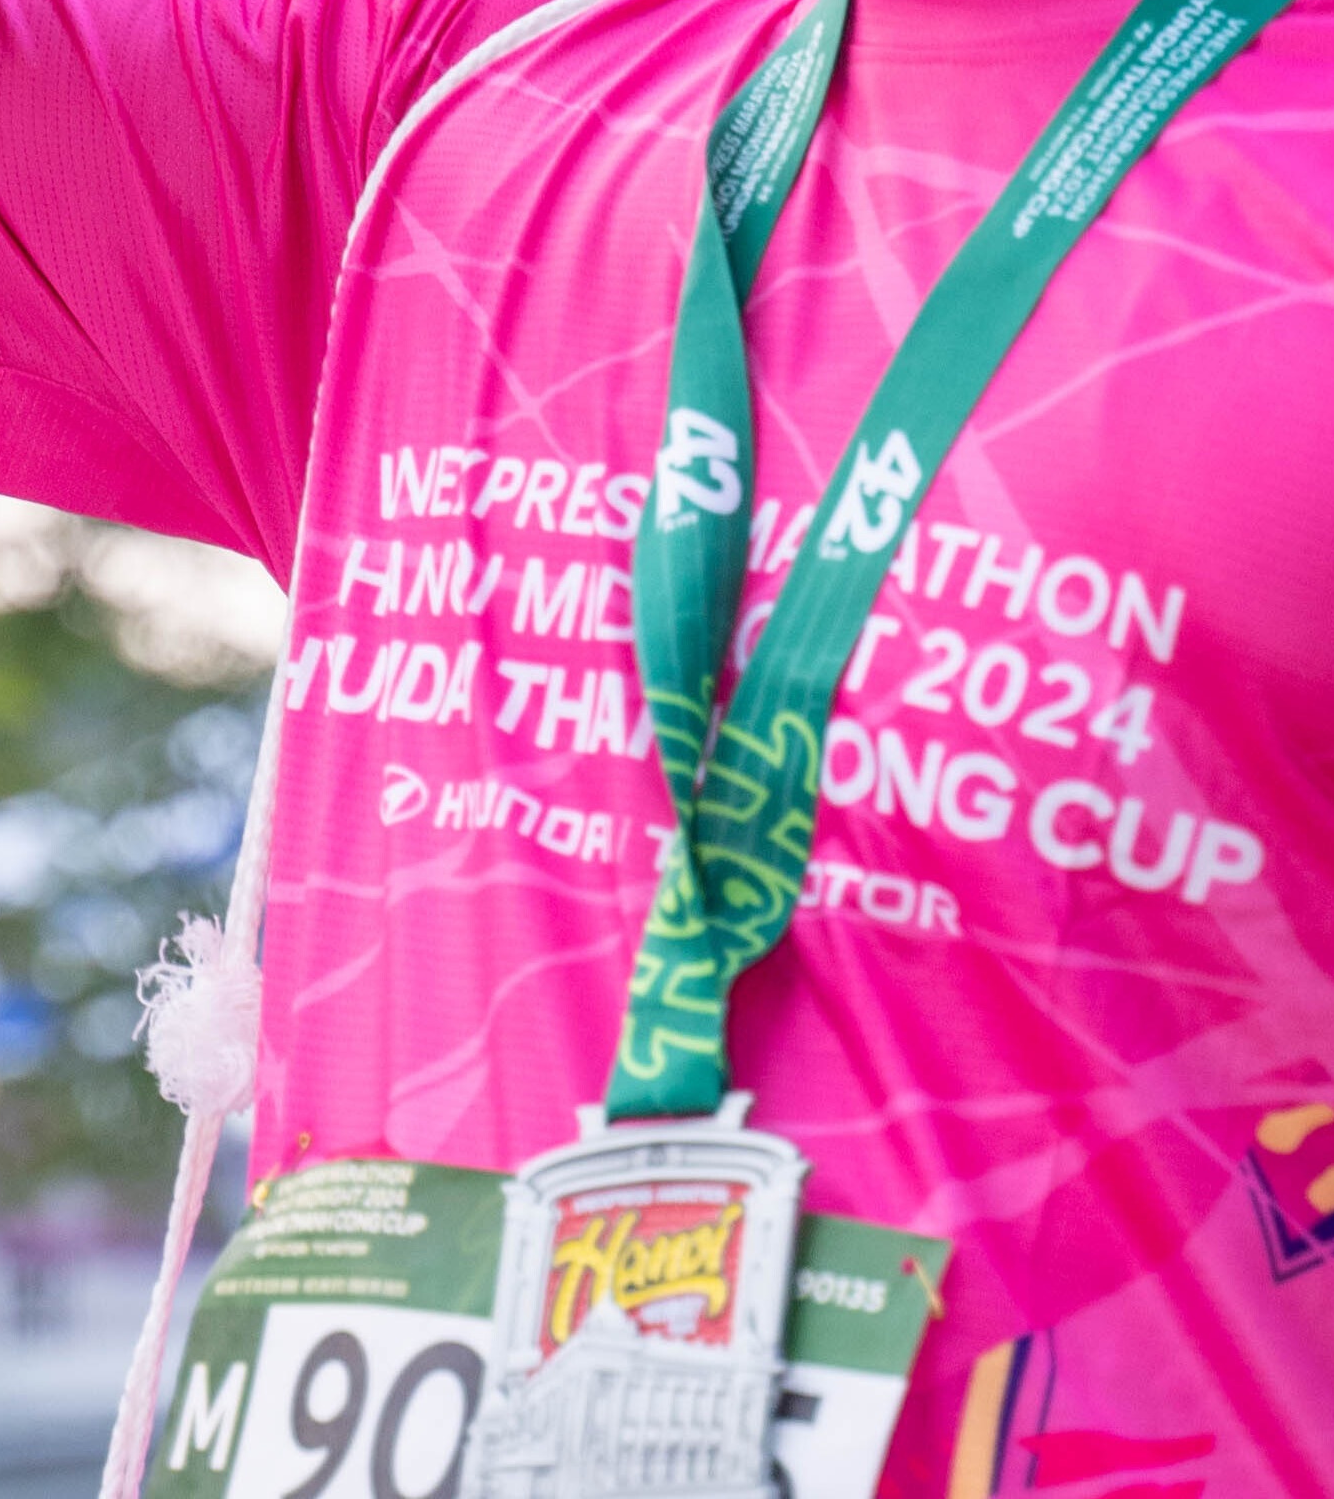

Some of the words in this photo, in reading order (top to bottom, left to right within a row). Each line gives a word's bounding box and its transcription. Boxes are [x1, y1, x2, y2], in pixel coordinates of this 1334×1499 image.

[1149, 17, 1245, 113] VNEXPRESS
[1166, 10, 1224, 68] HANOI
[1087, 66, 1168, 162] MIDNIGHT
[1047, 166, 1087, 215] 2024
[1065, 112, 1154, 219] MARATHON
[902, 627, 1152, 766] 2024
[821, 715, 1019, 842] ONG
[1027, 780, 1266, 905] CUP
[798, 859, 963, 939] OTOR
[169, 1362, 247, 1471] M
